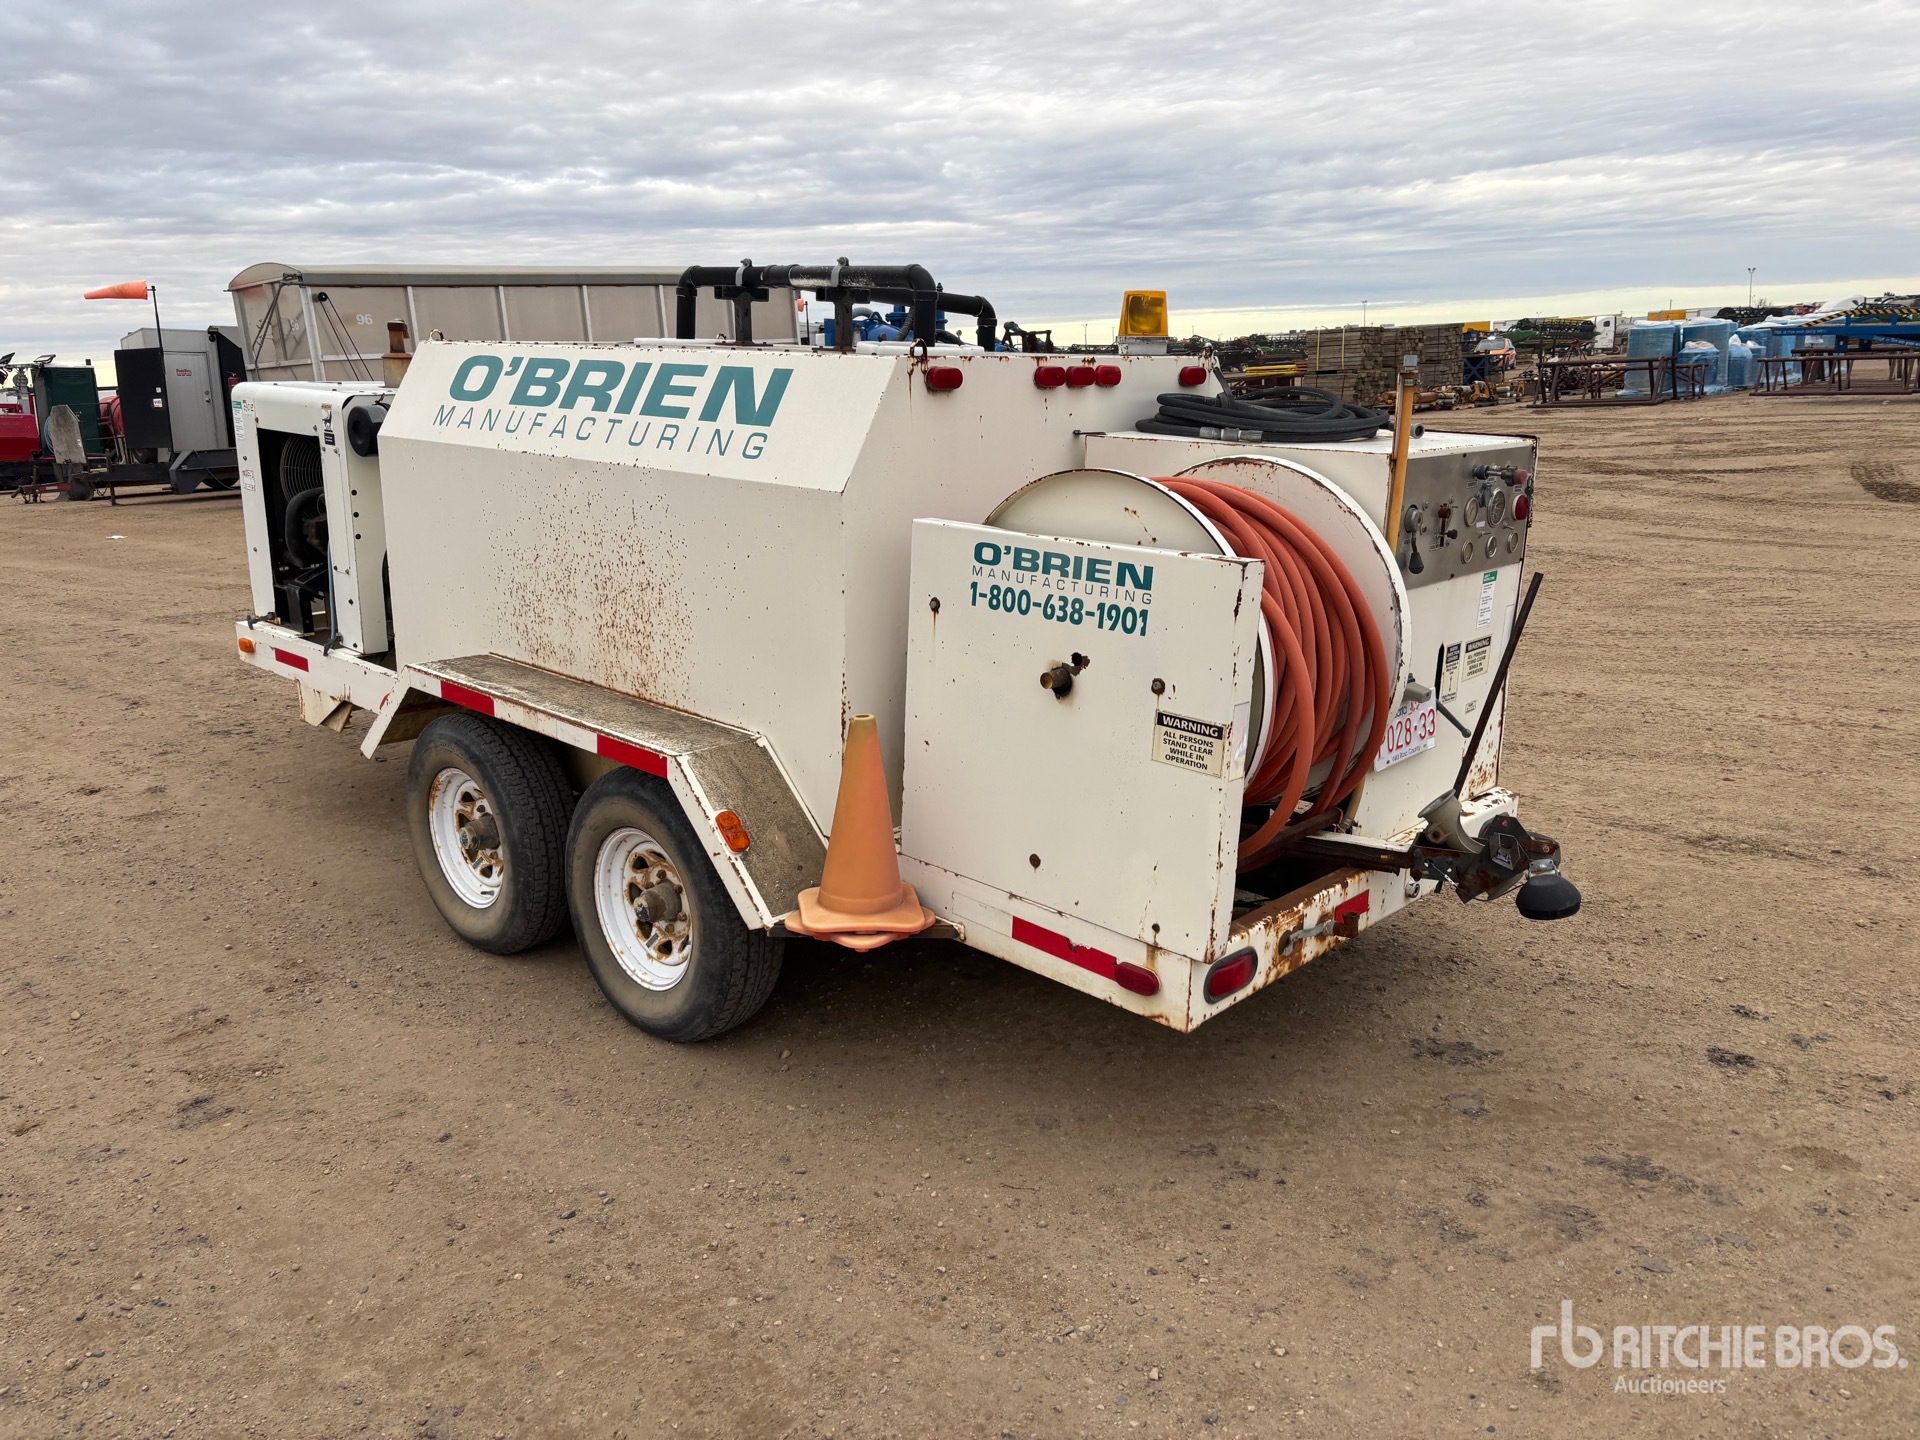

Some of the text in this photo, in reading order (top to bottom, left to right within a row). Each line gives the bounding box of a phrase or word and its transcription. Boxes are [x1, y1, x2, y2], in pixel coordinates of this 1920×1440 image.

[356, 313, 373, 325] 96
[449, 355, 794, 428] O'BRIEN
[432, 404, 768, 460] MANUFACTURING
[973, 541, 1154, 591] O'BRIEN
[972, 565, 1153, 605] MANUFACTURING
[970, 581, 1149, 637] 1-800-638-1901
[1467, 638, 1490, 651] WARNING
[1162, 715, 1219, 737] WARNING
[1163, 730, 1214, 748] ALL PERSONS
[1163, 738, 1213, 756] STAND CLEAR
[1165, 754, 1208, 771] OPERATION
[1169, 747, 1205, 762] WHILE IN
